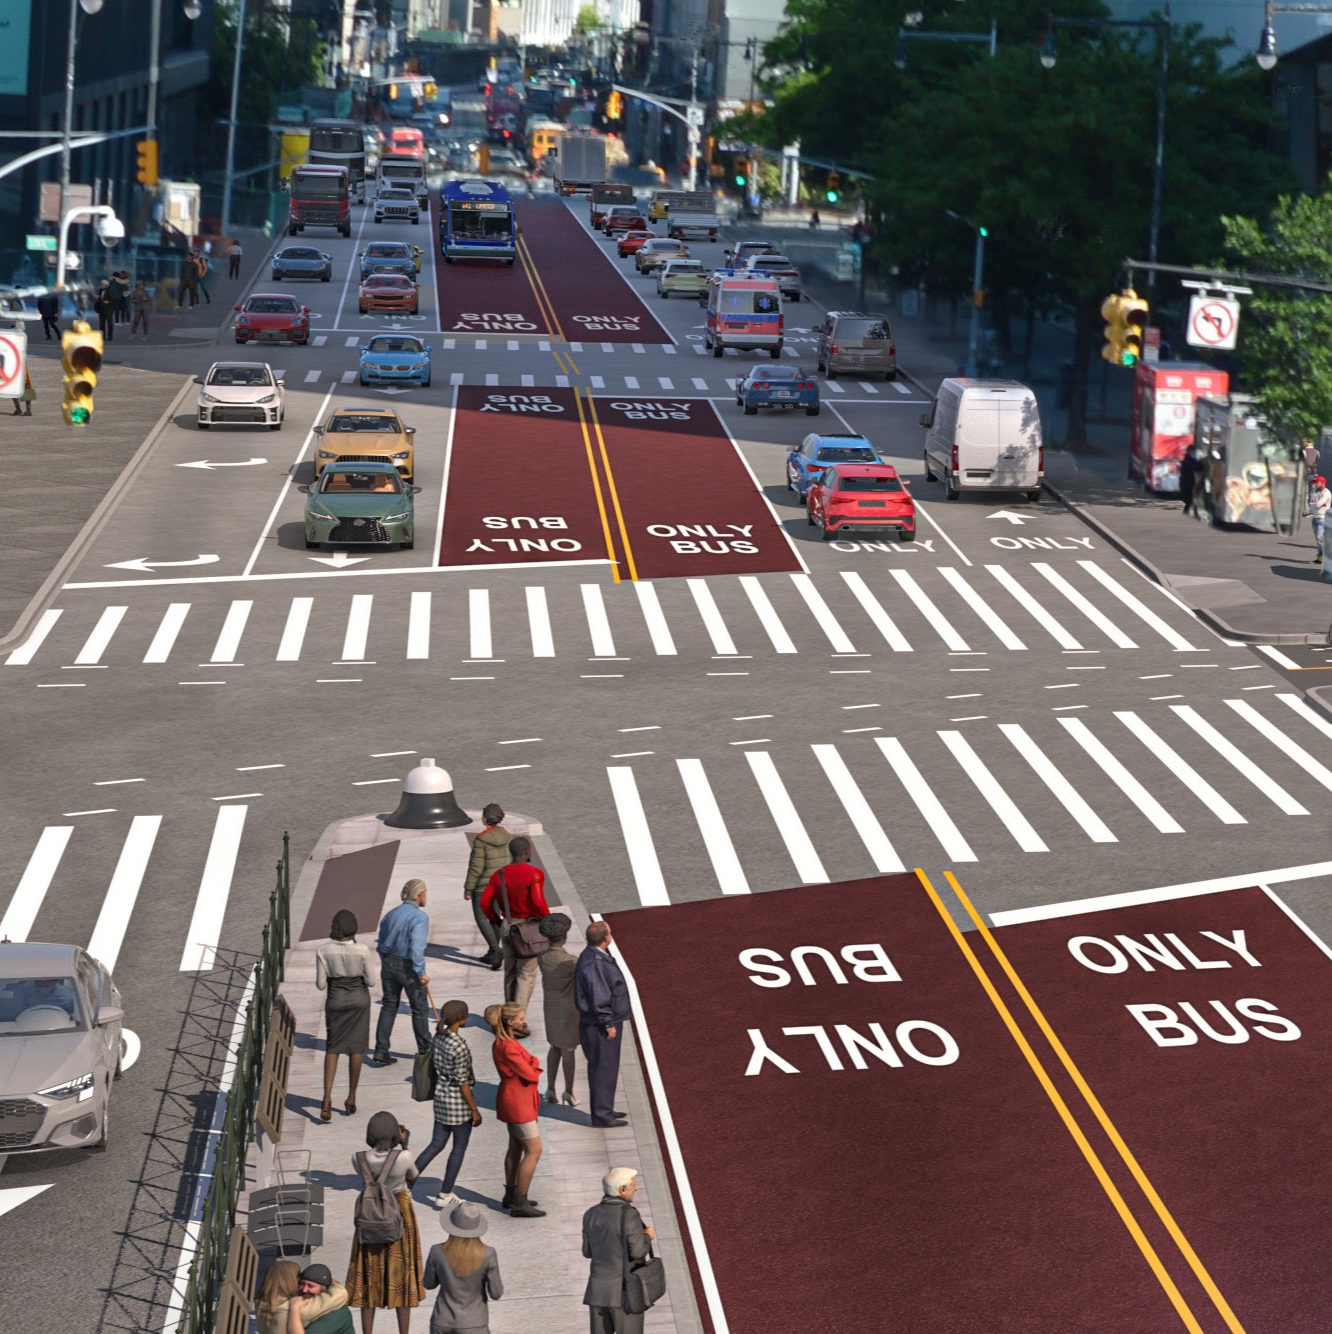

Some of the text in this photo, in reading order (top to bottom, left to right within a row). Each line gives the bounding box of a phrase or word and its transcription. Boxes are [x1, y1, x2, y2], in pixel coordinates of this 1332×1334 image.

[460, 313, 524, 322] BUS
[572, 315, 641, 323] ONLY
[453, 321, 538, 330] ONLY
[584, 323, 640, 331] BUS
[488, 395, 552, 403] BUS
[479, 403, 565, 412] ONLY
[610, 402, 692, 411] ONLY
[625, 411, 691, 420] BUS
[482, 517, 569, 529] BUS
[647, 524, 754, 537] ONLY
[466, 538, 582, 552] ONLY
[668, 541, 759, 554] BUS
[829, 539, 936, 552] ONLY
[990, 537, 1096, 549] ONLY
[1067, 929, 1262, 974] ONLY
[738, 943, 902, 988] BUS
[1124, 998, 1302, 1047] BUS
[744, 1020, 960, 1076] ONLY
